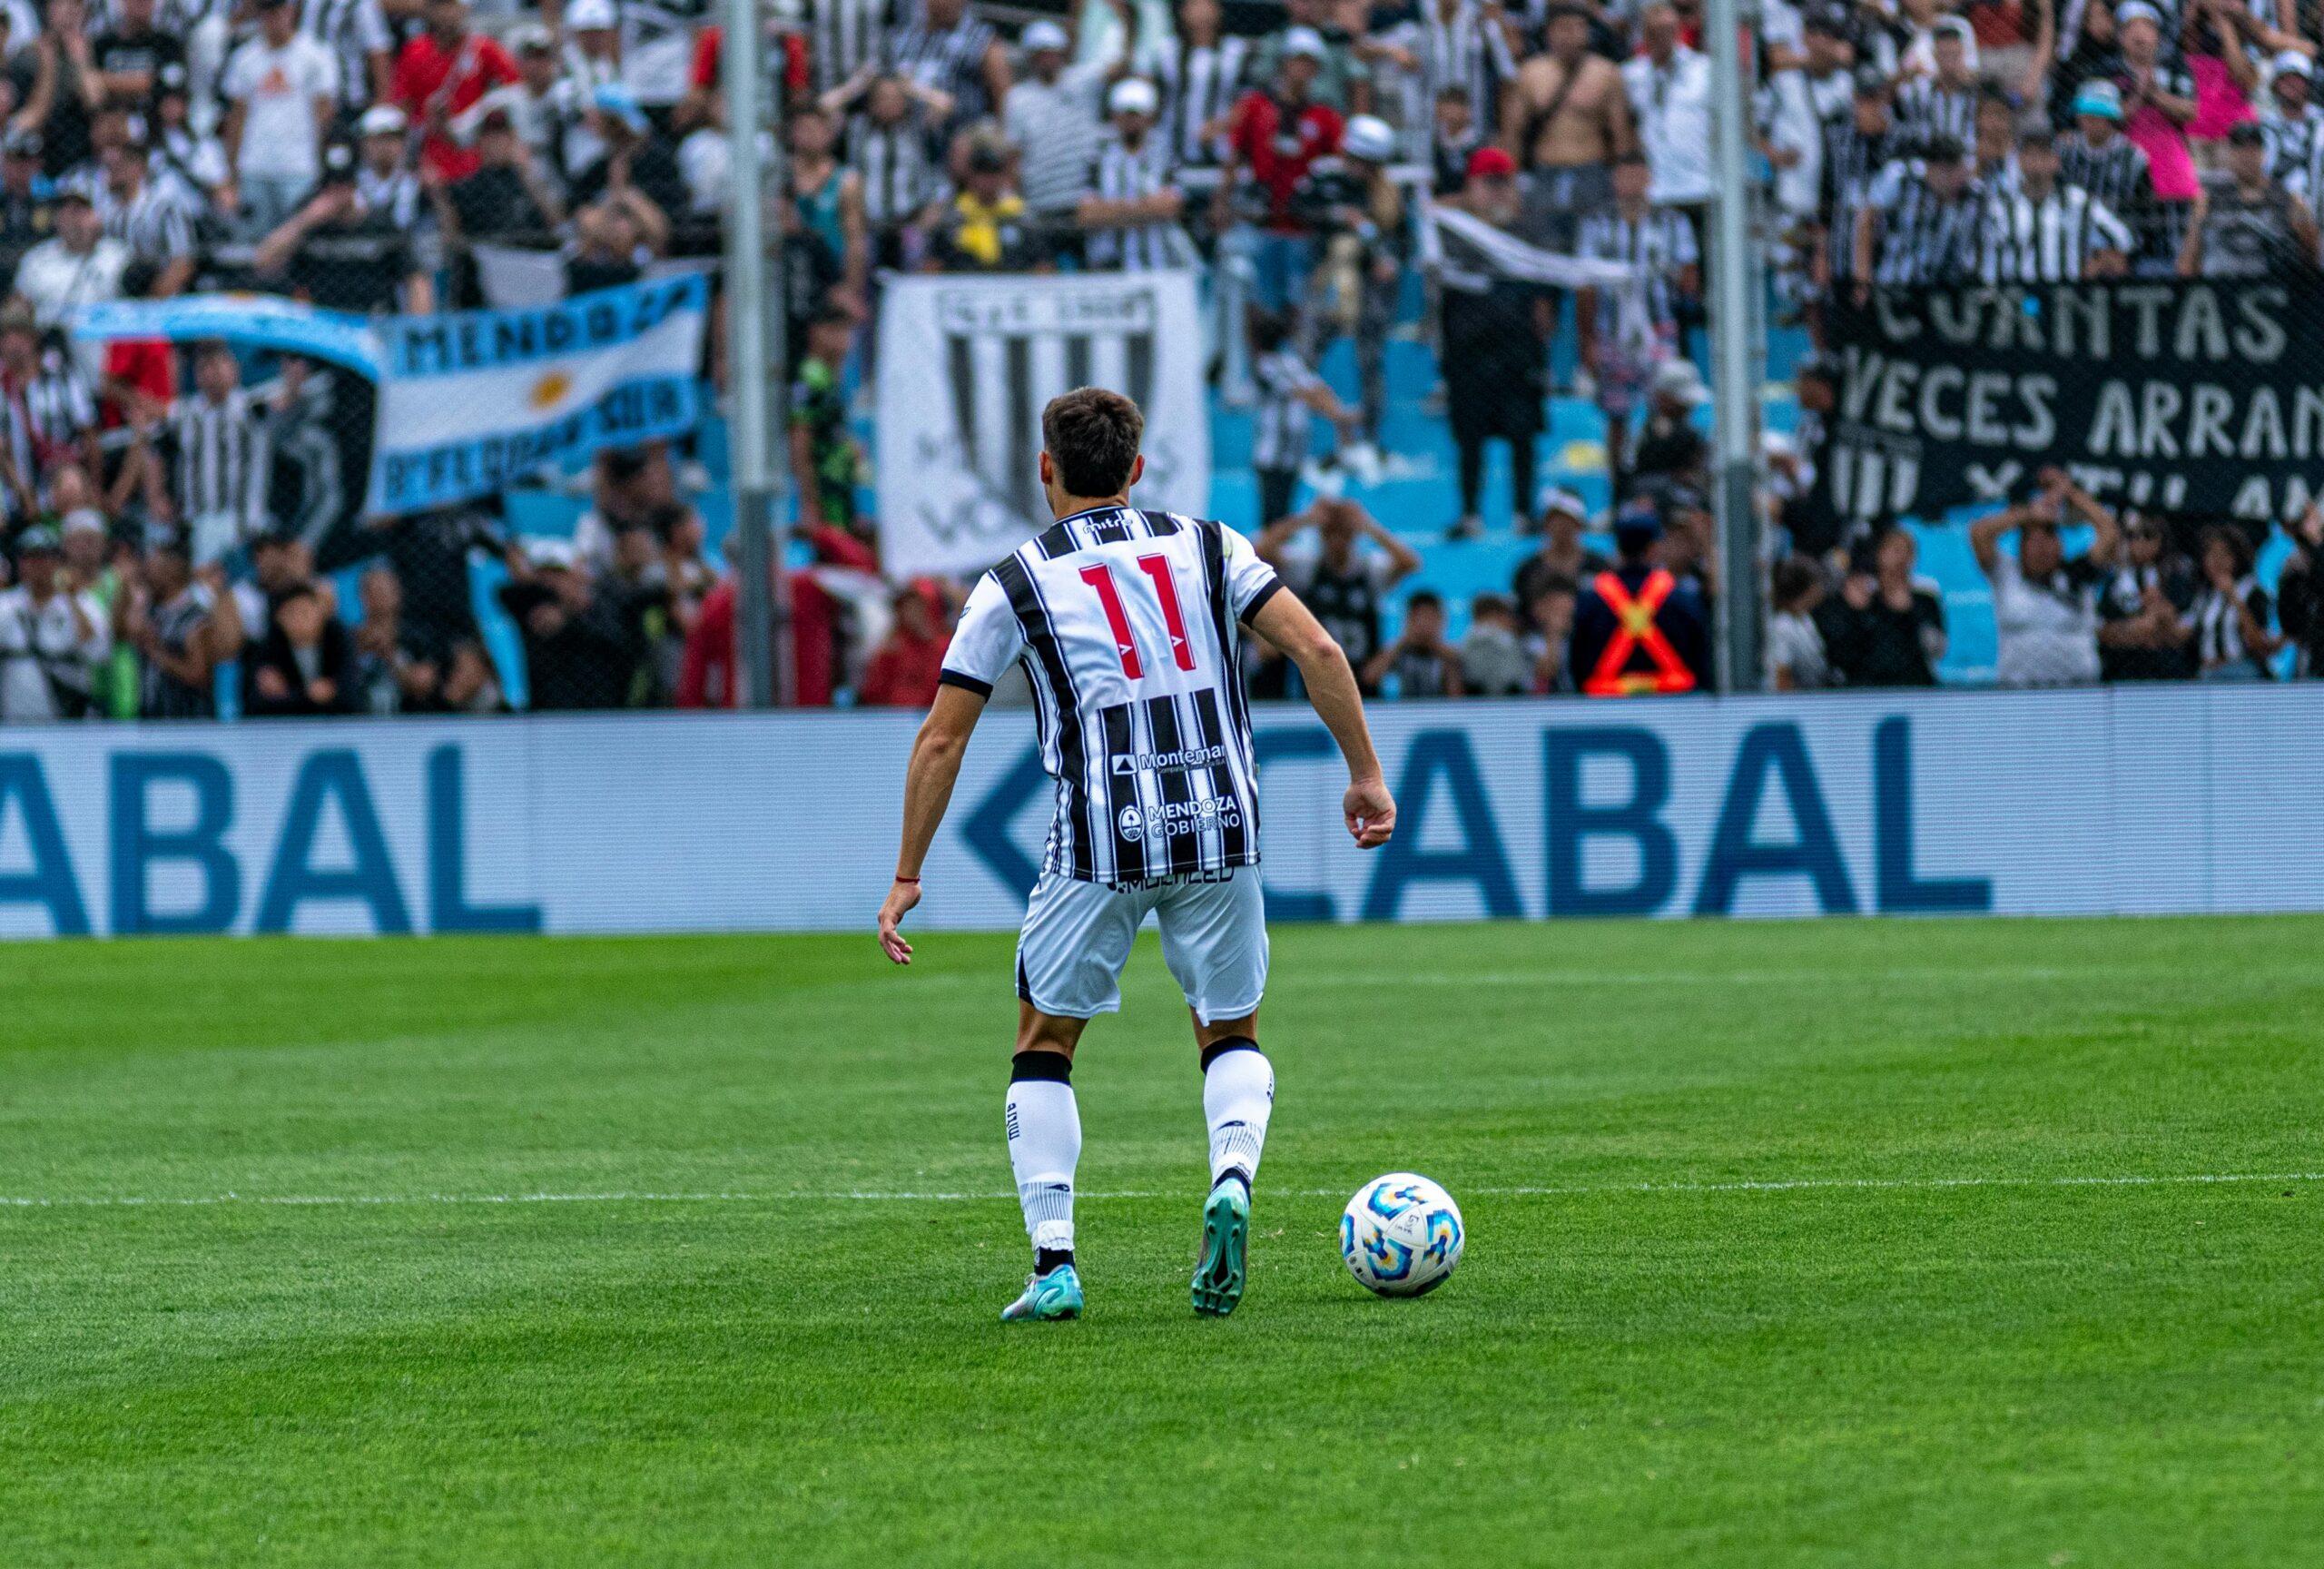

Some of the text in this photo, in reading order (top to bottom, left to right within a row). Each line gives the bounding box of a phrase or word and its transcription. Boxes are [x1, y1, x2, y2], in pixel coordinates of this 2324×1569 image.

[1840, 347, 2059, 451] VECES
[1082, 516, 1134, 534] mitre
[1078, 552, 1197, 681] 11
[1147, 794, 1237, 822] MENDOZA
[1150, 813, 1240, 839] GOBIERNO
